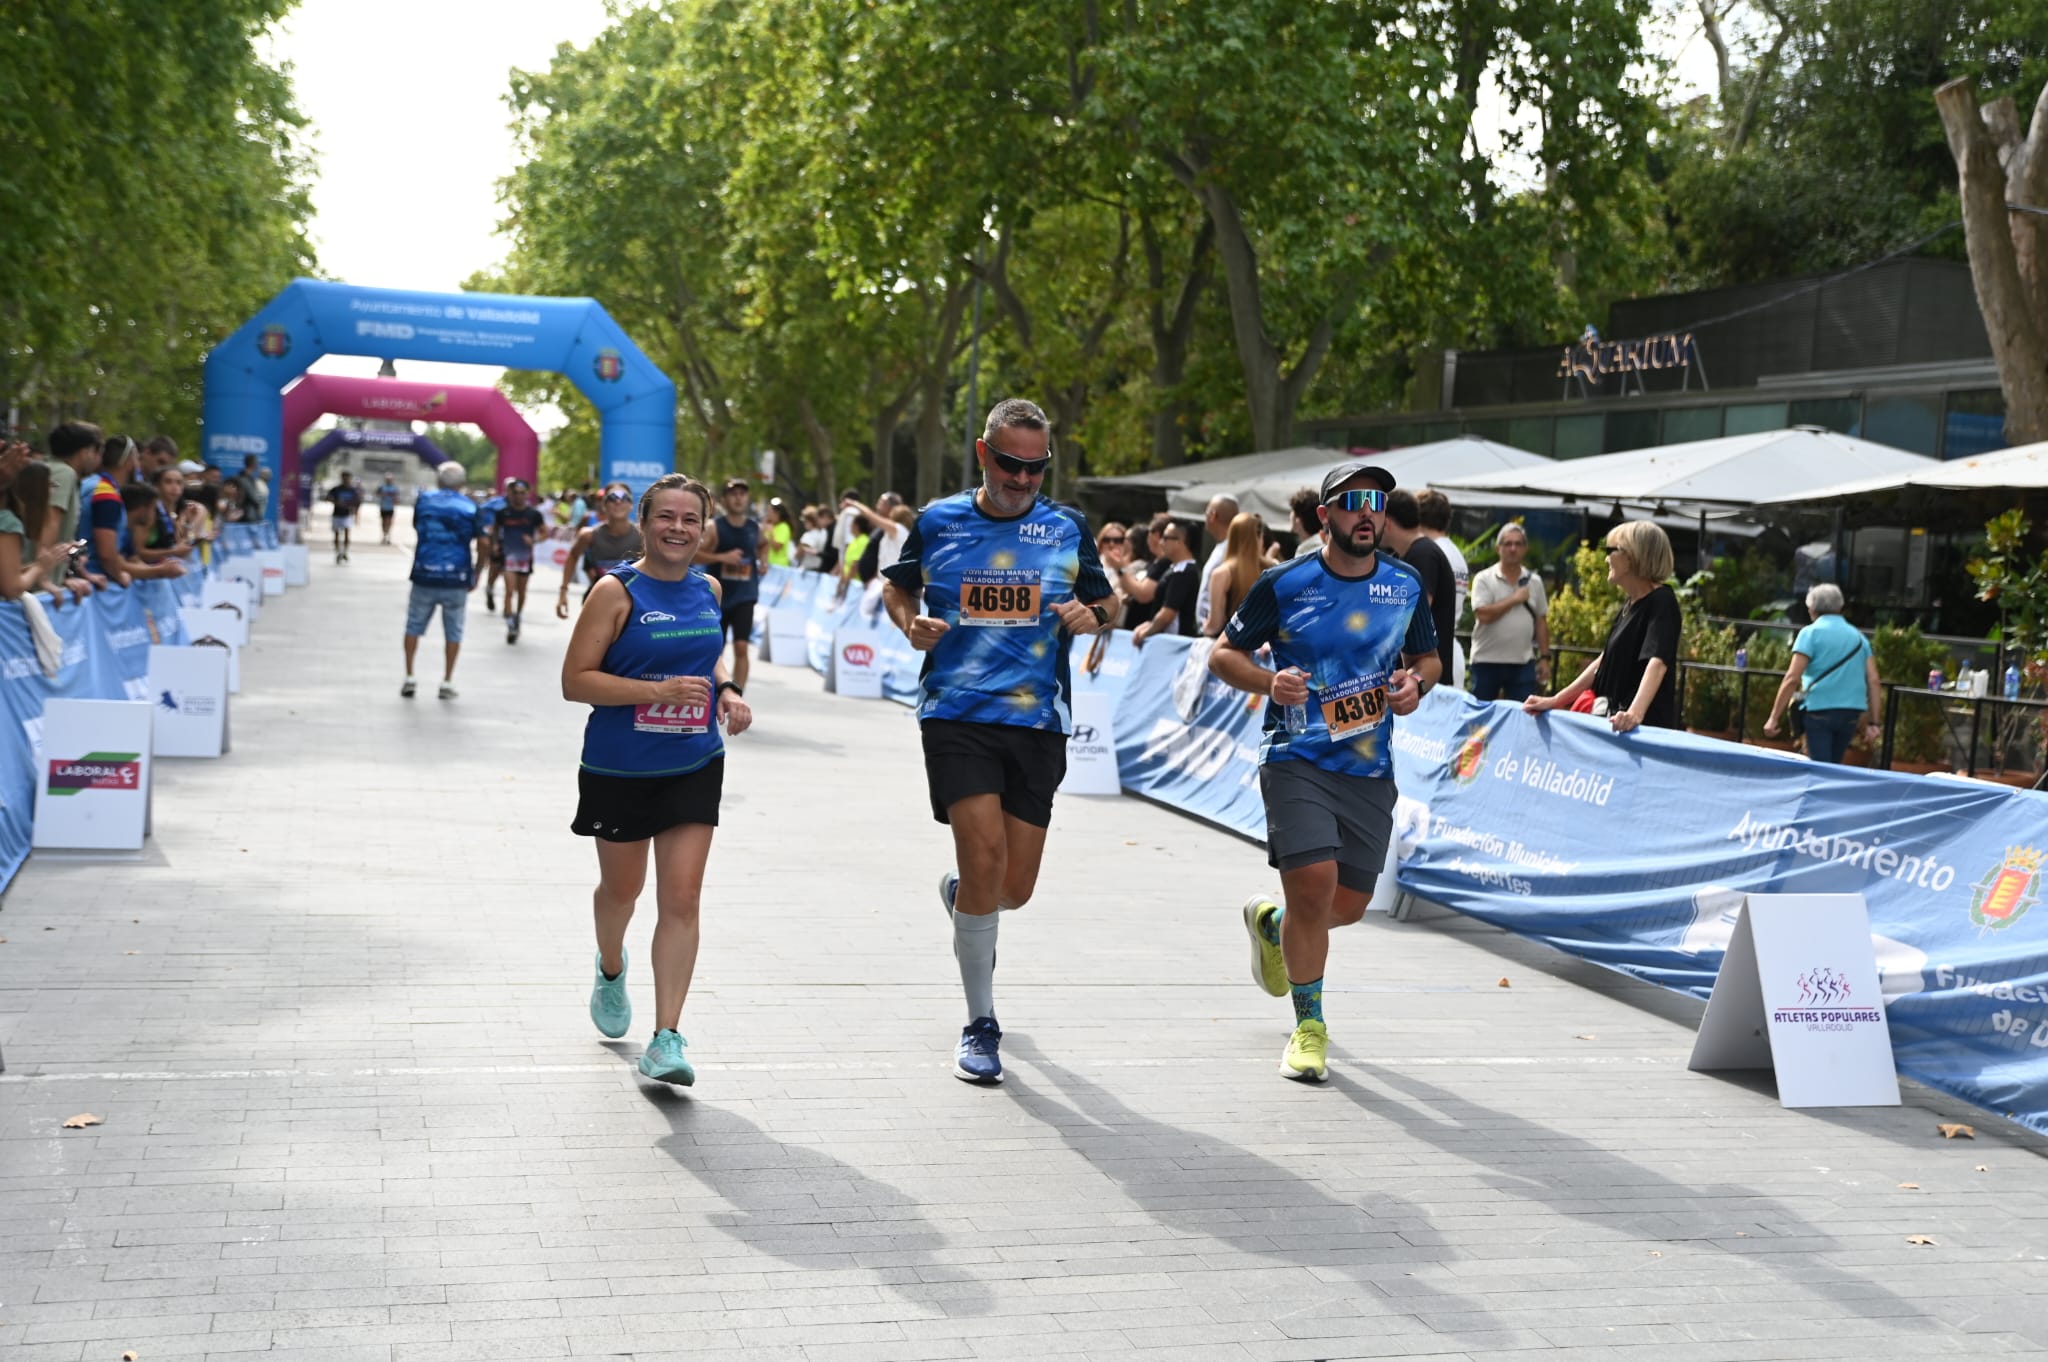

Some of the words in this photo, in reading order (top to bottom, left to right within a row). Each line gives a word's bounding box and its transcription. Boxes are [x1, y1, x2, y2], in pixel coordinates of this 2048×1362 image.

[357, 320, 415, 340] FMD
[1369, 583, 1408, 597] MM26
[968, 586, 1031, 612] 4698
[1369, 597, 1407, 605] VALLADOLID
[1338, 678, 1360, 689] MEDIA
[1320, 686, 1360, 703] VALLADOLID
[1067, 745, 1109, 755] YUNDAI
[56, 765, 118, 777] LABORAL
[1494, 751, 1519, 782] de
[1520, 755, 1615, 807] Valladolid
[1432, 816, 1505, 857] Fundación
[1728, 810, 1955, 892] Ayuntamiento
[1775, 1012, 1818, 1022] ATLETAS
[1821, 1012, 1880, 1022] POPULARES
[1992, 1009, 2029, 1037] de
[1807, 1024, 1853, 1032] VALLADOLID
